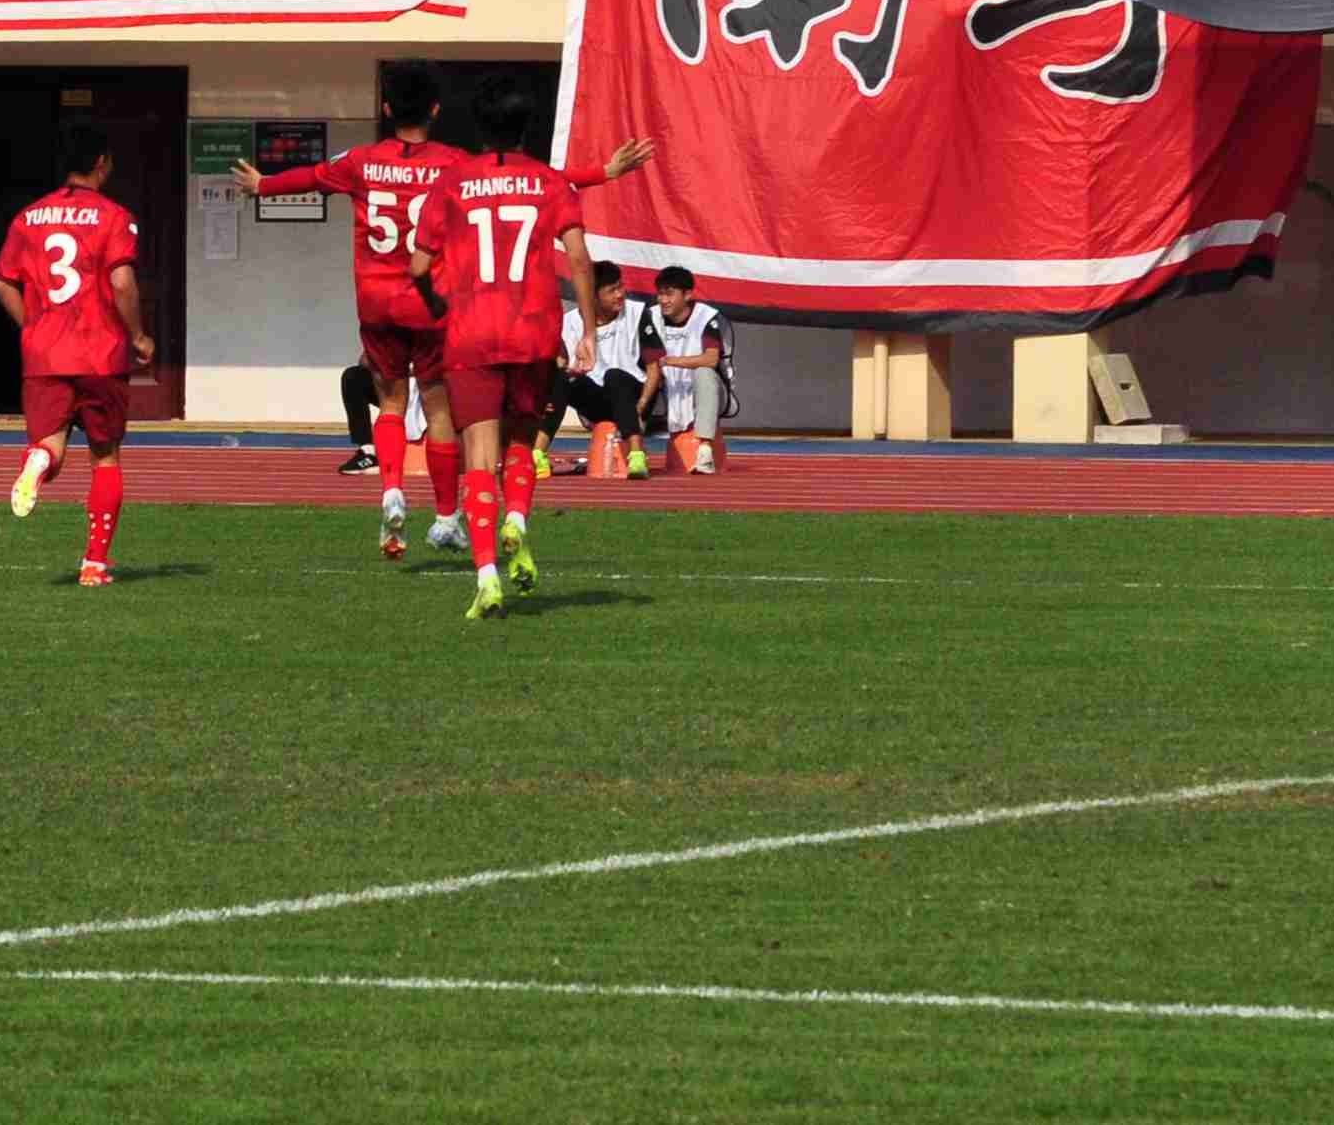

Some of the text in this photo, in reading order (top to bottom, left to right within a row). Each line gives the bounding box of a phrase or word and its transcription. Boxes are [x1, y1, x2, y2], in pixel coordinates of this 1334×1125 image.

[363, 164, 412, 183] HUANG
[459, 176, 514, 200] ZHANG
[468, 205, 538, 283] 17
[43, 233, 82, 305] 3
